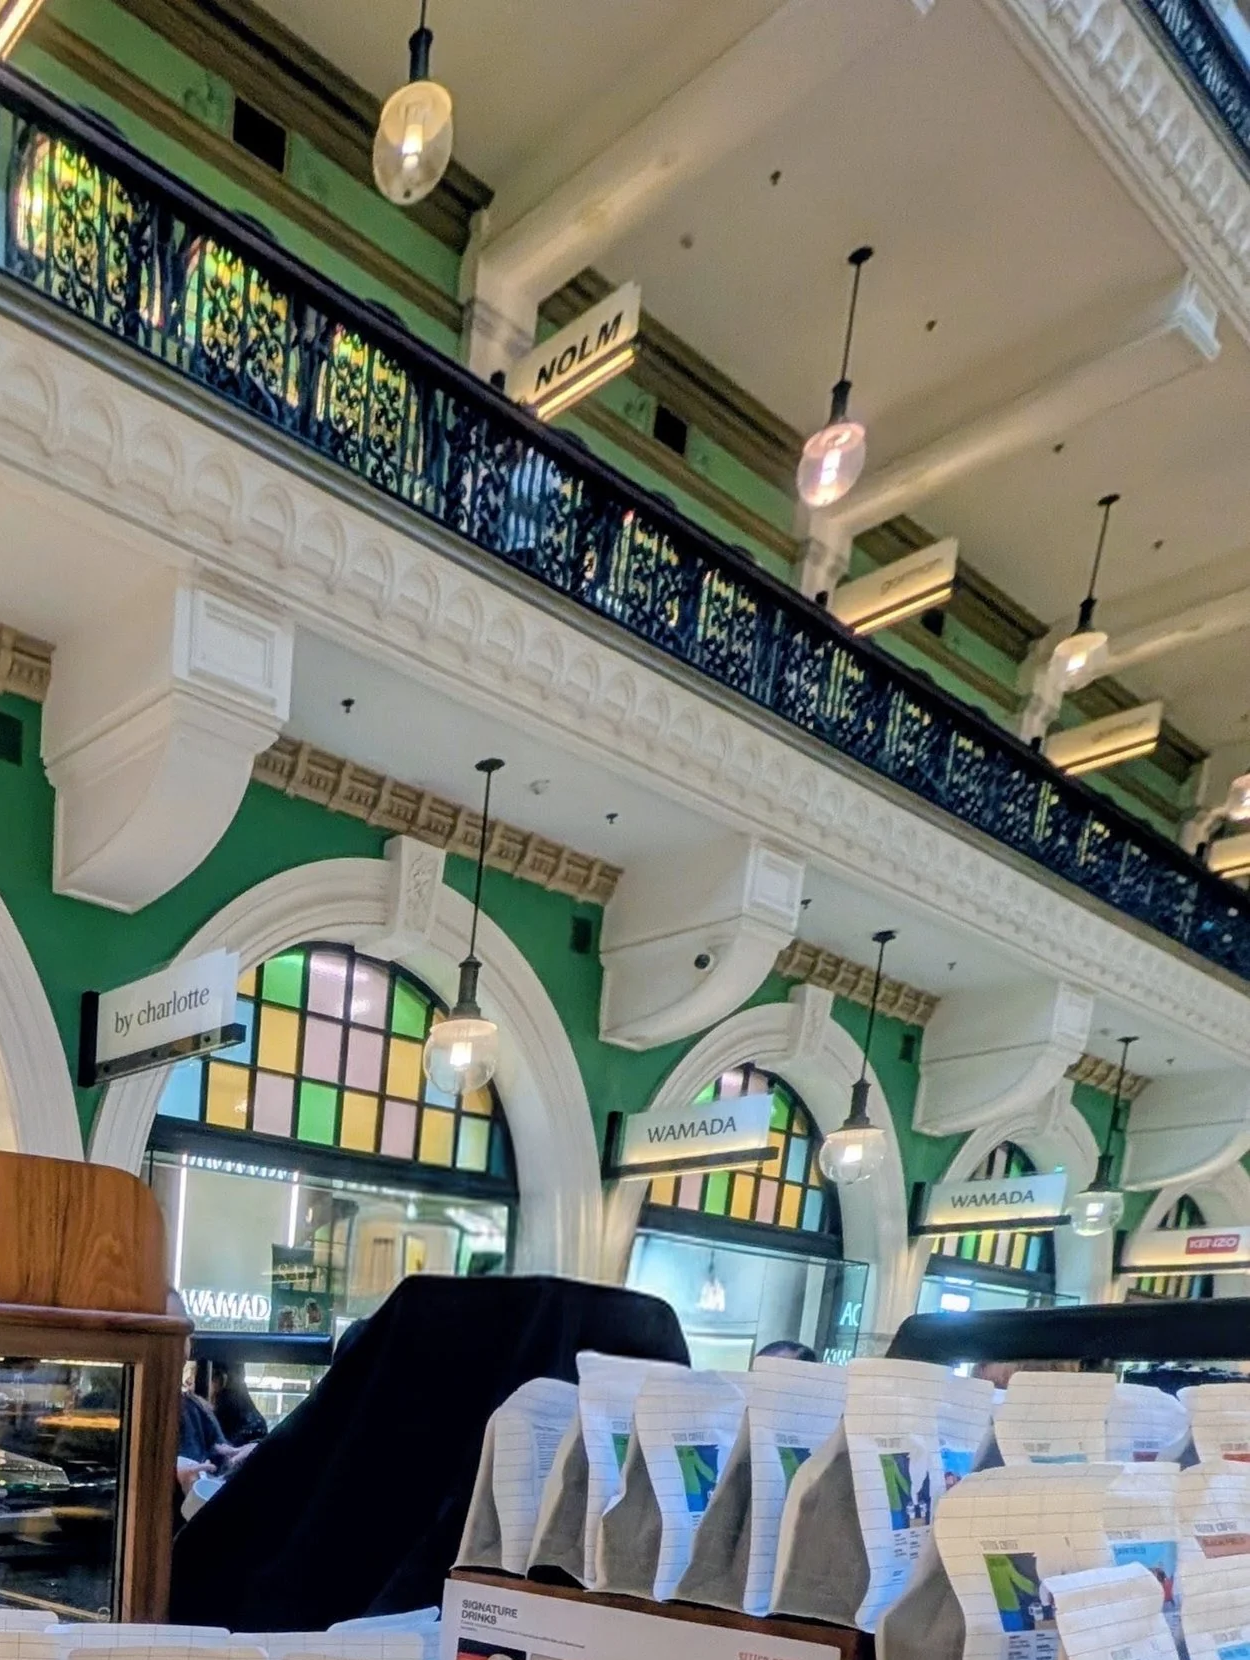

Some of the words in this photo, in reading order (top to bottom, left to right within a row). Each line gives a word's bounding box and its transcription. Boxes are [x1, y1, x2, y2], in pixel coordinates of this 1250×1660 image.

[534, 310, 623, 393] NOLM
[115, 1011, 133, 1037] by
[137, 988, 210, 1026] charlotte
[647, 1116, 737, 1143] WAMADA
[951, 1189, 1034, 1208] WAMADA
[462, 1600, 518, 1619] SIGNATURE
[462, 1610, 497, 1625] DRINKS
